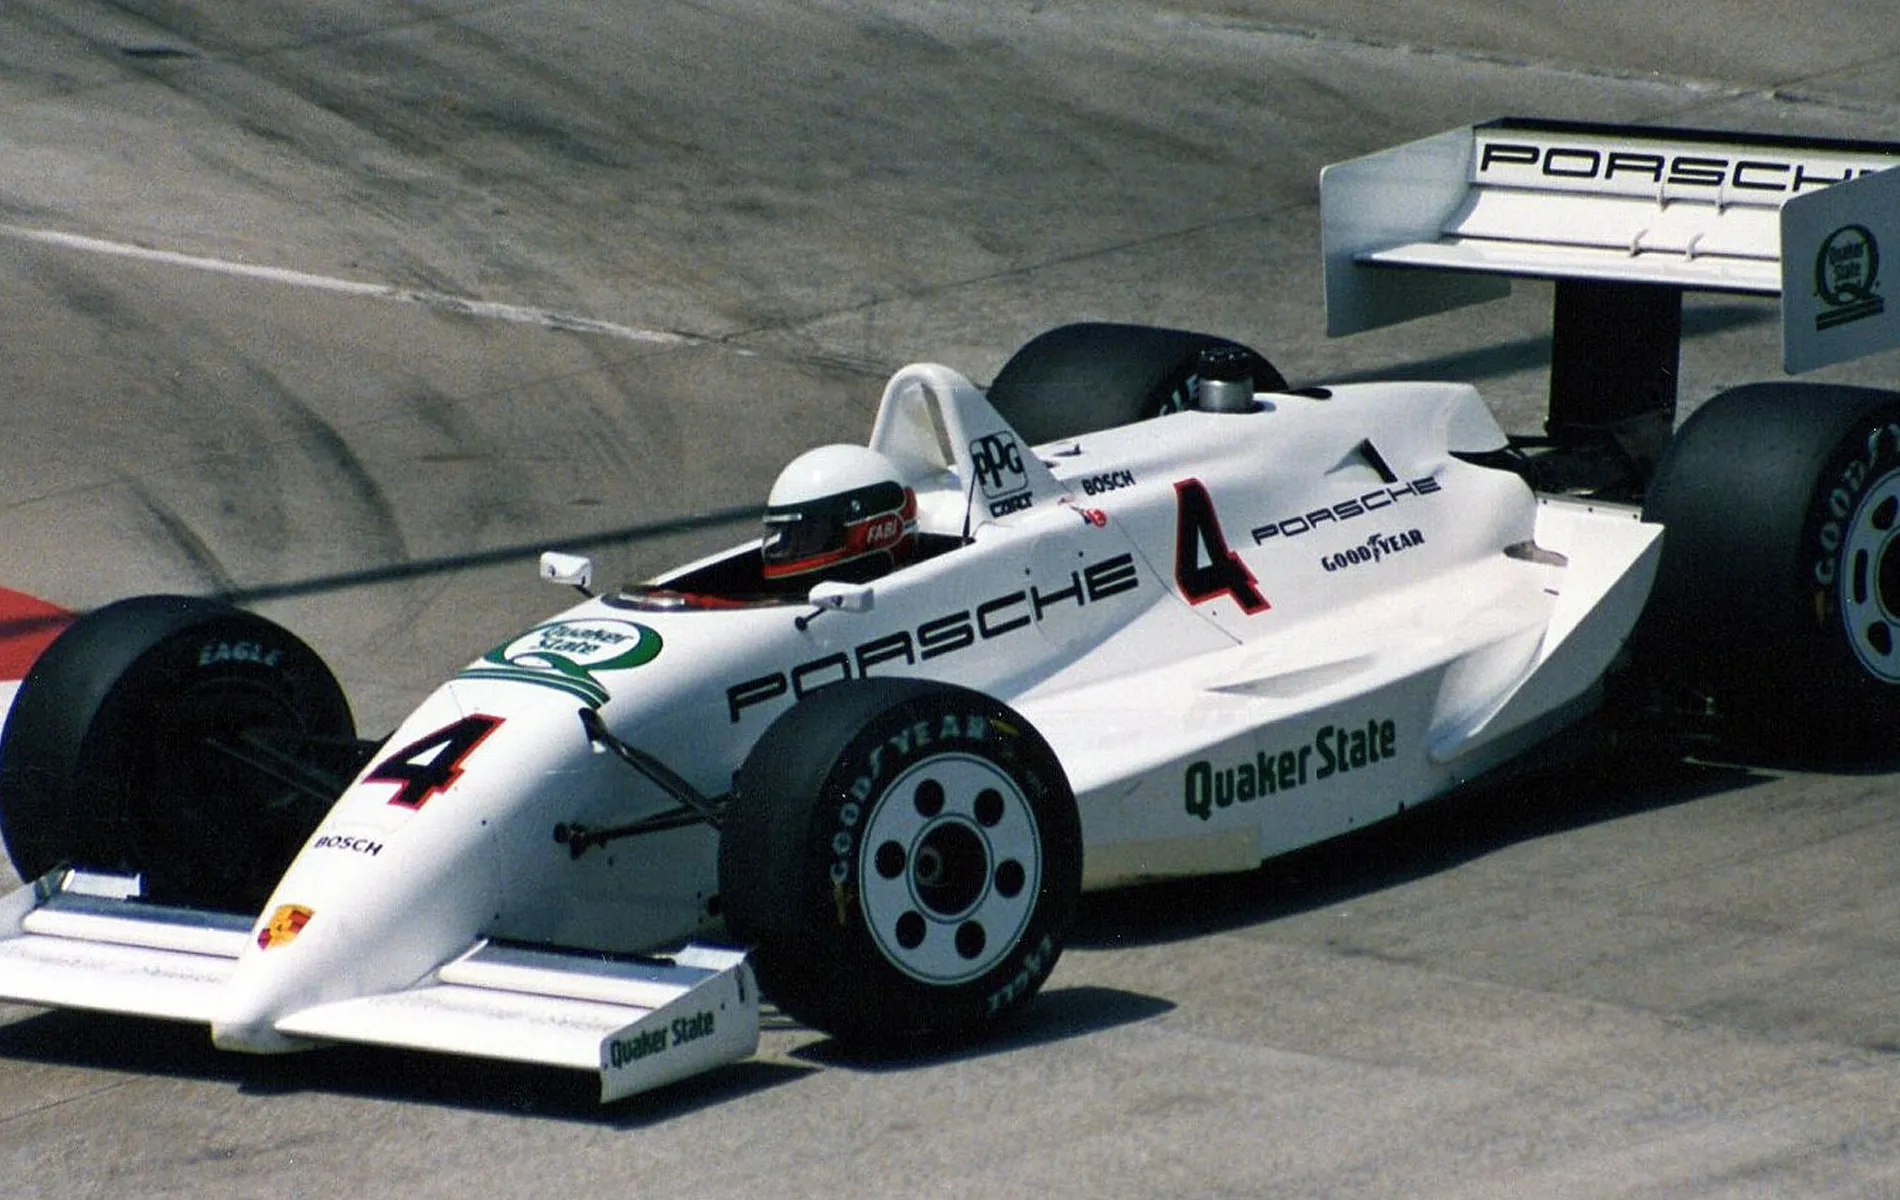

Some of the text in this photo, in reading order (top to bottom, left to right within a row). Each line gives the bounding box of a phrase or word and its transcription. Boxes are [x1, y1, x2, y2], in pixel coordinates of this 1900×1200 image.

[1480, 143, 1878, 192] PORSCH
[972, 434, 1024, 489] PPG
[1081, 469, 1137, 496] BOSCH
[866, 518, 898, 544] FABI
[1250, 475, 1442, 547] PORSCHE
[1172, 476, 1273, 617] 4
[1321, 528, 1426, 573] GOODYEAR
[197, 638, 285, 669] EAGLE
[538, 637, 601, 655] State
[540, 624, 635, 645] Quaker
[725, 552, 1140, 724] PORSCHE
[361, 712, 506, 811] 4
[1184, 718, 1397, 821] Quaker State
[314, 835, 384, 857] BOSCH
[609, 1010, 716, 1069] Quaker State
